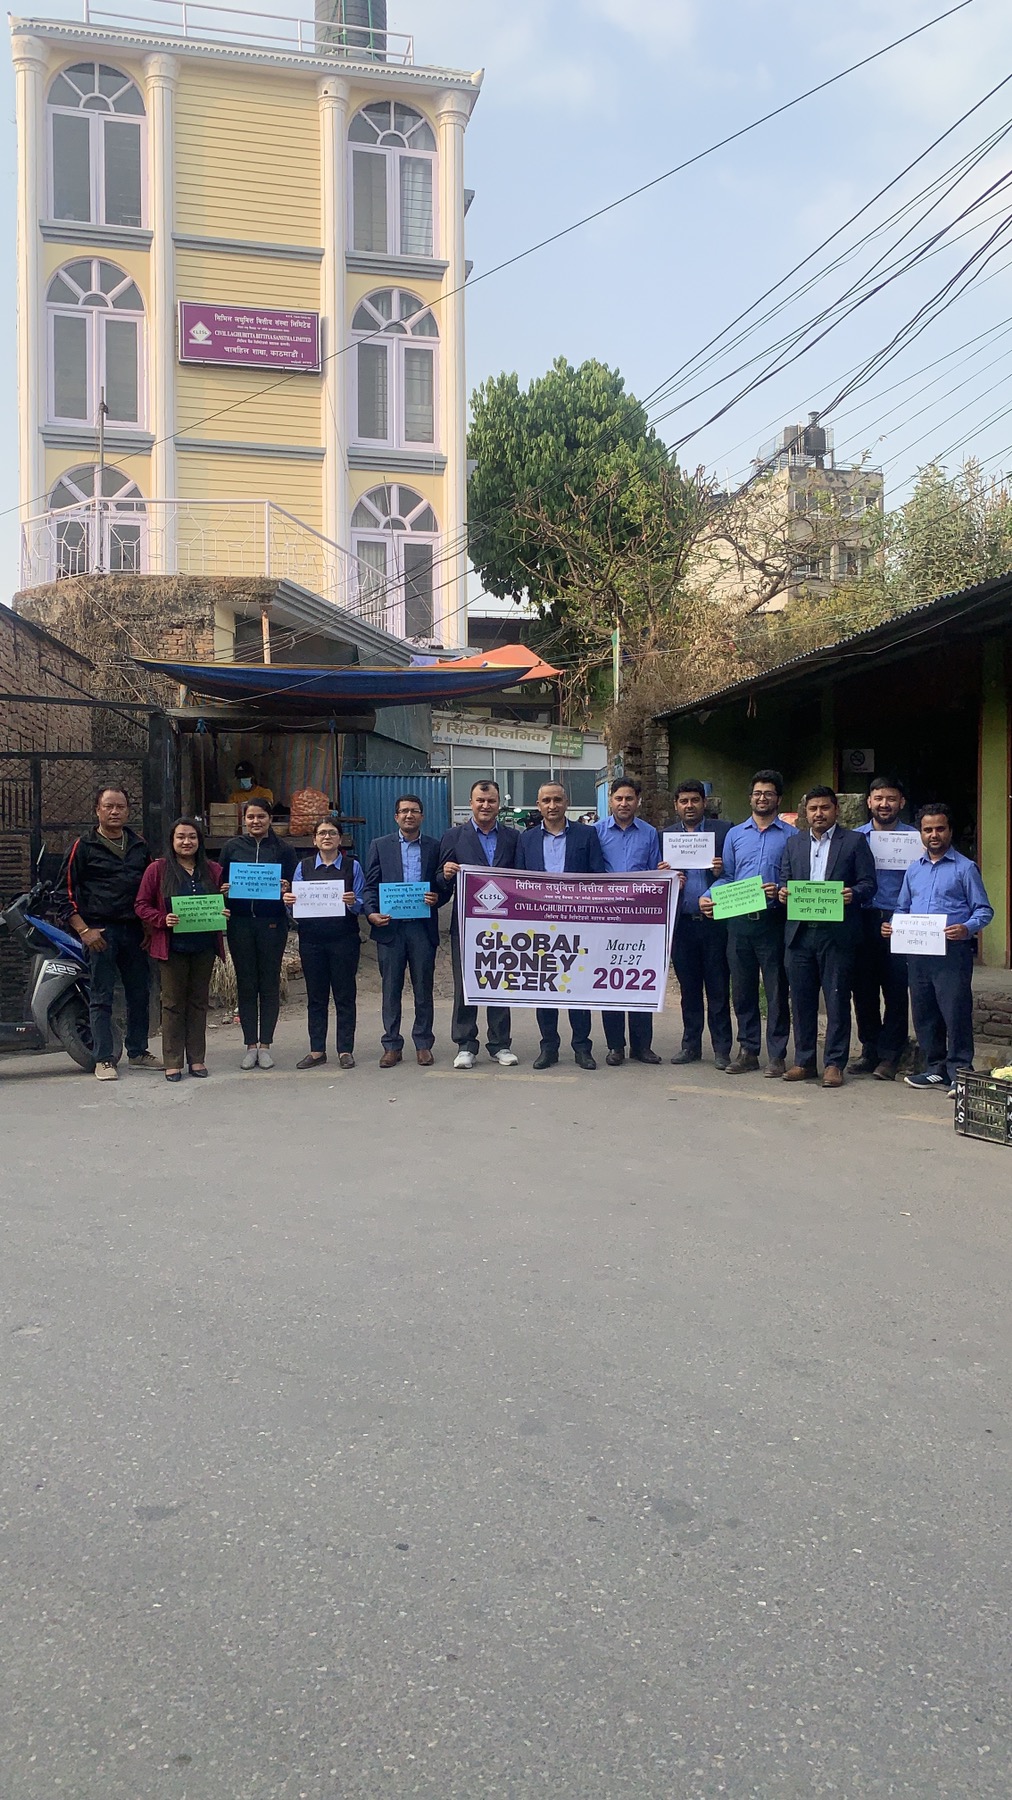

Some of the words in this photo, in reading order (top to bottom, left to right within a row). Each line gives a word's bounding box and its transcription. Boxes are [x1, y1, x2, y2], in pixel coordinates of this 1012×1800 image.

[446, 722, 479, 736] सिटी
[515, 879, 542, 891] सिभिल
[545, 881, 575, 894] लघुवित्त
[578, 882, 604, 893] वित्तीय
[607, 884, 629, 894] संस्था
[632, 883, 664, 895] लिमिटेड
[514, 902, 534, 911] CIVIL
[534, 903, 576, 913] LAGHUBITTA
[577, 905, 603, 913] BITTIYA
[604, 906, 634, 914] SANSTHA
[635, 907, 663, 915] LIMITED
[475, 931, 588, 954] GLOBAL
[605, 939, 646, 951] March
[475, 951, 578, 972] MONEY
[610, 954, 642, 965] 21-27
[474, 970, 558, 991] WEEK
[592, 967, 656, 990] 2022
